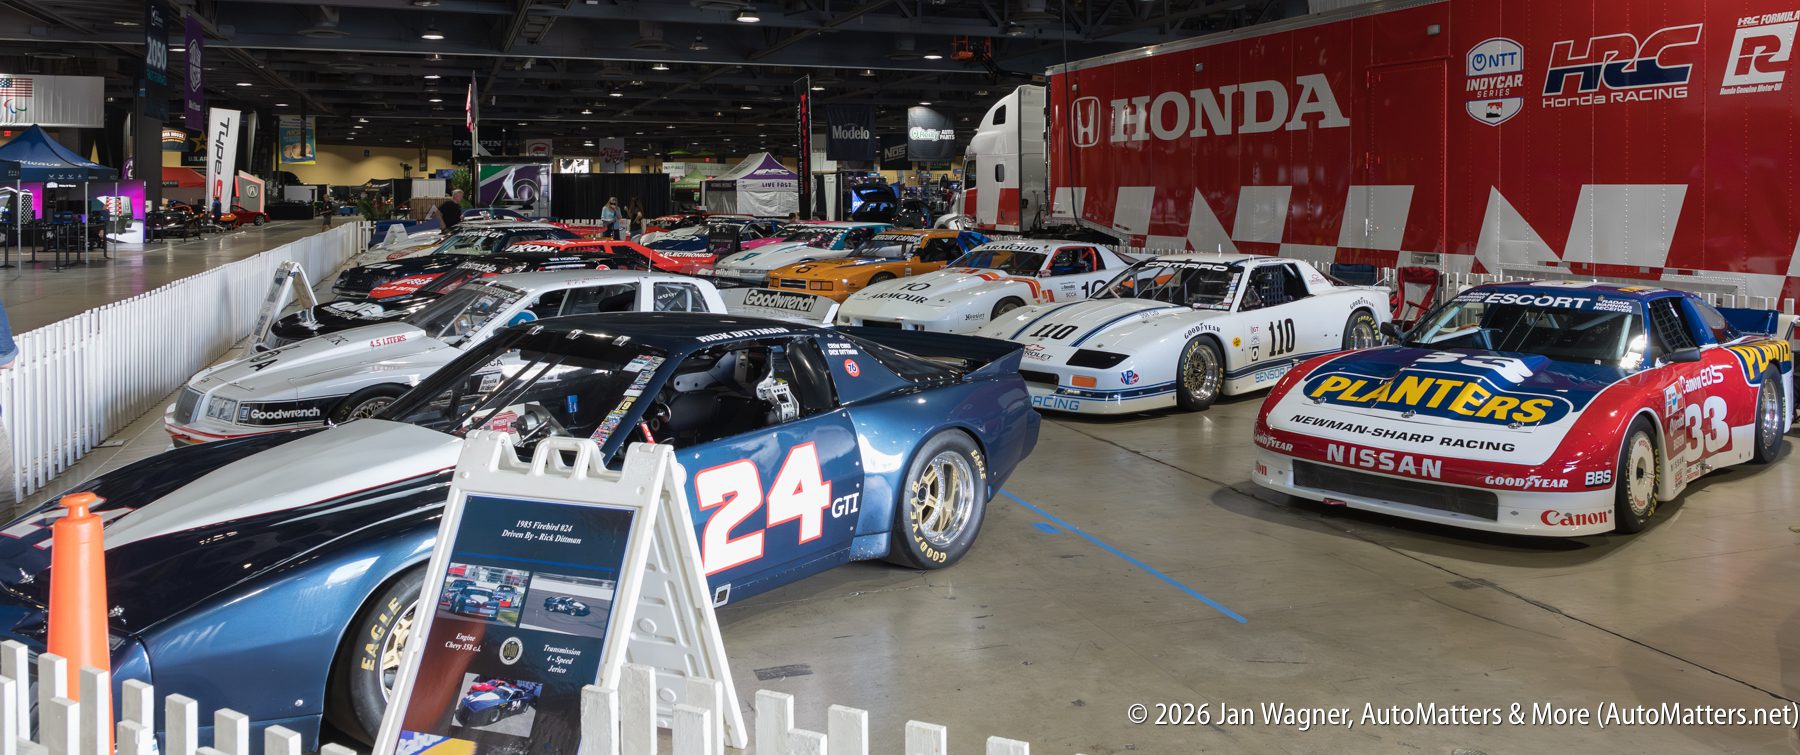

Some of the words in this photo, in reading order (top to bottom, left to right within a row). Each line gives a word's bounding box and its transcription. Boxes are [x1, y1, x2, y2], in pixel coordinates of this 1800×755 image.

[1760, 10, 1800, 25] FORMULA
[146, 36, 167, 71] 2050
[1488, 52, 1517, 68] NTT
[1542, 23, 1703, 96] HRC
[1466, 74, 1523, 91] INDYCAR
[1477, 88, 1510, 98] SERIES
[1542, 93, 1606, 109] Honda
[1610, 87, 1688, 103] RACING
[1110, 73, 1350, 143] HONDA
[832, 125, 870, 140] Modelo
[214, 117, 231, 175] Type
[453, 139, 501, 147] GAPIN
[884, 144, 907, 159] NOS
[664, 251, 714, 259] ELECTRONICS
[983, 244, 1039, 252] ARMOUR
[1145, 261, 1229, 272] CAMARO
[899, 282, 931, 292] 10
[744, 288, 816, 312] Goodwrench
[871, 292, 928, 304] ARMOUR
[1484, 293, 1591, 309] ESCORT
[1595, 302, 1633, 310] WARNING
[1593, 305, 1633, 313] RECEIVER
[696, 333, 732, 343] RICK
[731, 326, 790, 339] DITTMAN
[1030, 323, 1078, 340] 110
[1184, 322, 1221, 340] GOODYEAR
[1269, 318, 1296, 357] 110
[383, 335, 407, 345] LITERS
[1121, 370, 1134, 385] VP
[1255, 367, 1285, 383] SENSOR
[1679, 374, 1703, 395] Canon
[1031, 395, 1080, 411] ACING
[1309, 375, 1554, 423] PLANTERS
[251, 406, 321, 420] Goodwrench
[1289, 414, 1435, 444] NEWMAN-SHARP
[1439, 437, 1516, 453] RACING
[1685, 395, 1732, 465] 33
[969, 449, 987, 481] EAGLE
[1326, 443, 1442, 479] NISSAN
[1485, 475, 1569, 489] GOODYEAR
[1585, 469, 1612, 487] BBS
[693, 440, 832, 578] 24
[831, 492, 859, 519] GTI
[516, 519, 533, 529] 1985
[532, 521, 561, 532] Firebird
[560, 524, 573, 533] #24
[909, 480, 948, 565] GOODYEAR
[1540, 509, 1608, 527] Canon
[501, 529, 524, 539] Driven
[524, 531, 534, 541] By
[538, 533, 554, 542] Rick
[554, 534, 582, 545] Dittman
[361, 596, 404, 672] EAGLE
[455, 632, 476, 642] Engine
[445, 641, 462, 651] Chevy
[461, 643, 473, 651] 358
[543, 644, 582, 656] Transmission
[555, 656, 574, 666] Speed
[547, 665, 567, 674] Jerico
